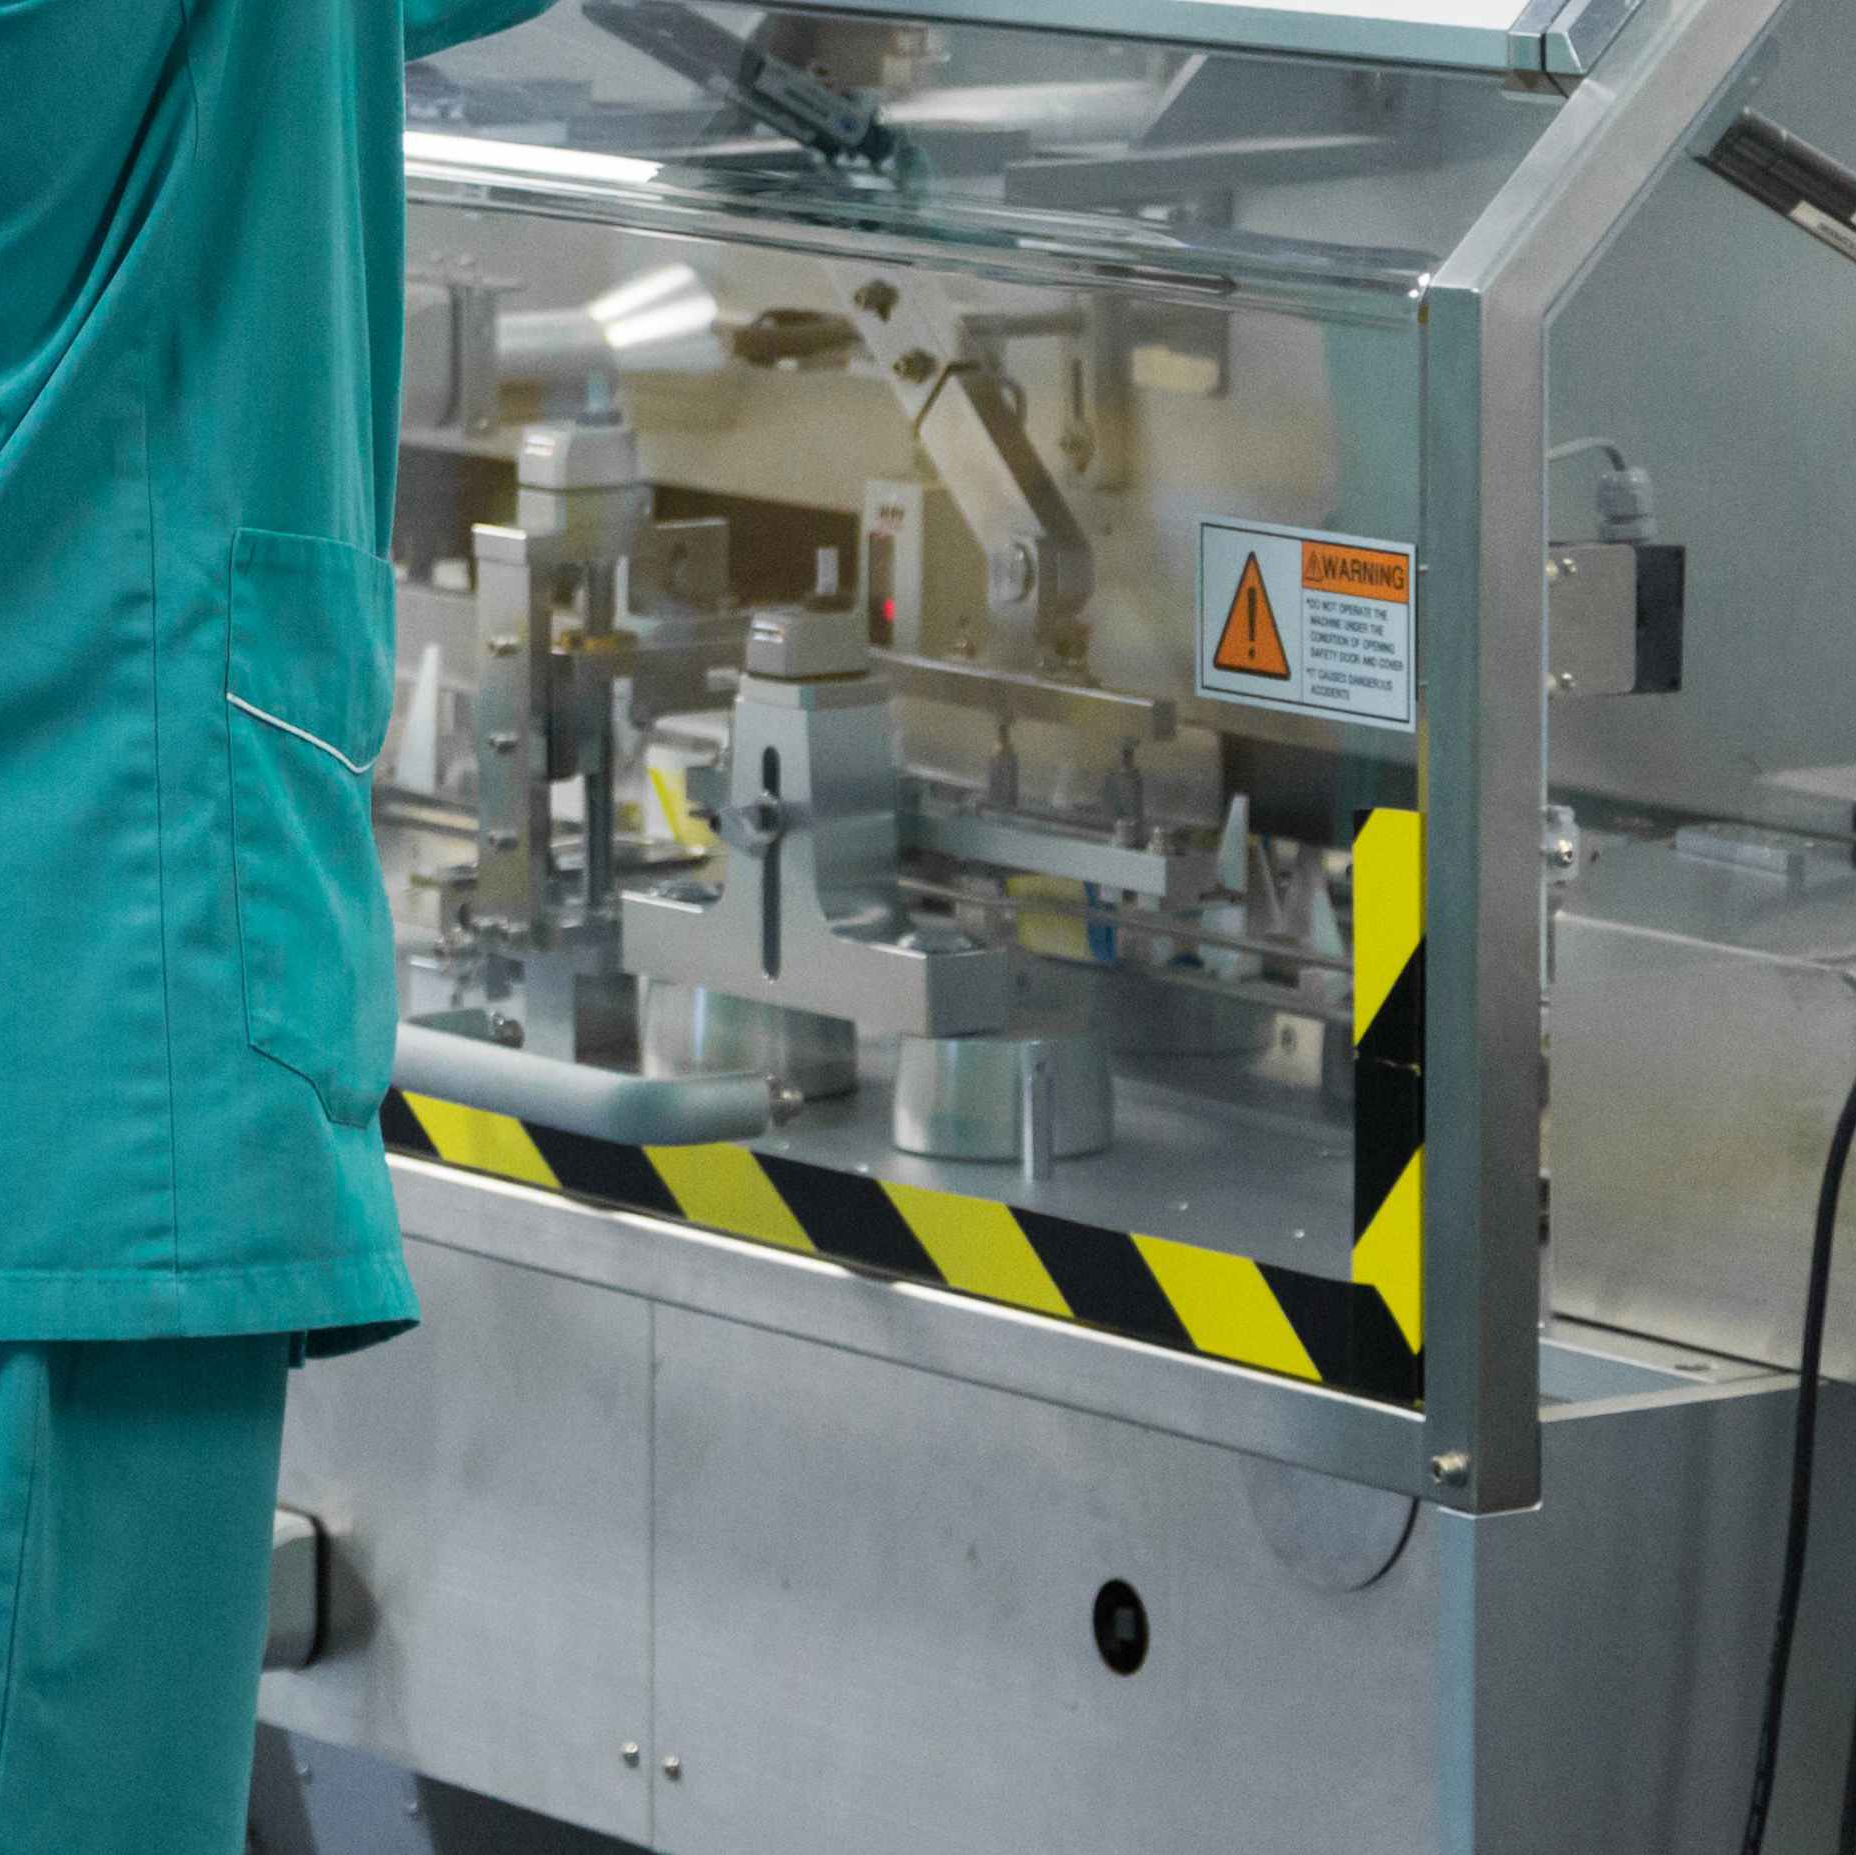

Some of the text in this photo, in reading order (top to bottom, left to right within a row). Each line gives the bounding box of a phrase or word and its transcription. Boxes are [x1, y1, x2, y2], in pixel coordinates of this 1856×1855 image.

[1323, 555, 1404, 590] WARNING
[1310, 616, 1341, 629] MACHINE
[1310, 647, 1337, 660] SAFETY
